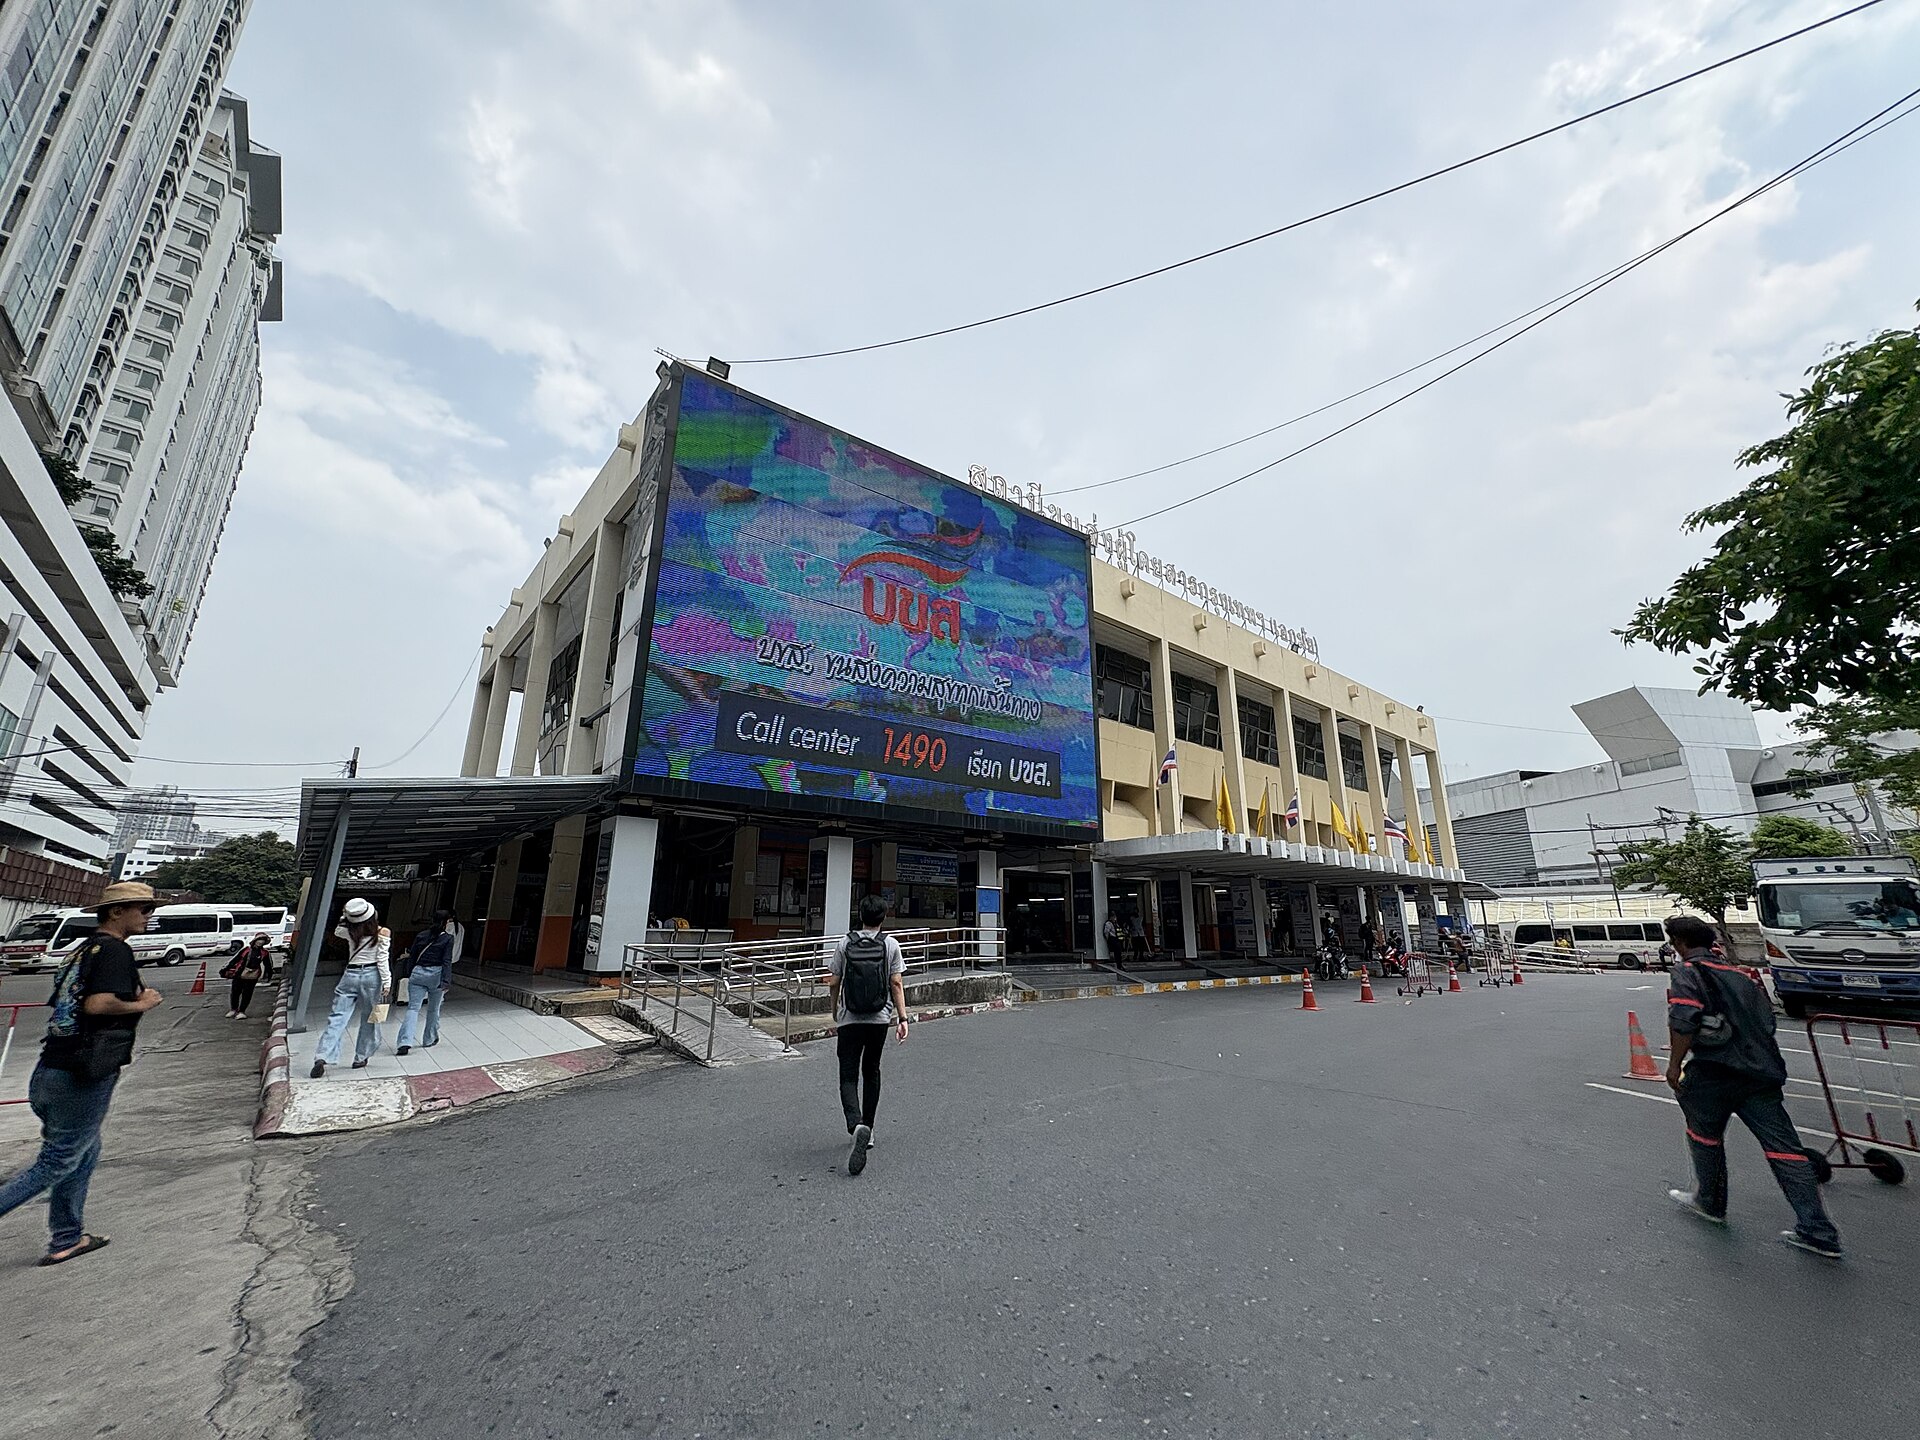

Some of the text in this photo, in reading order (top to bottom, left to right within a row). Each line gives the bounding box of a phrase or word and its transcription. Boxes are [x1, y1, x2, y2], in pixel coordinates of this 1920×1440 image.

[863, 577, 960, 643] บขส
[757, 636, 1041, 720] บขส. ขนส่งความสุขทุกเส้นทาง
[736, 711, 1051, 788] Call center 1490 เรียก บขส.
